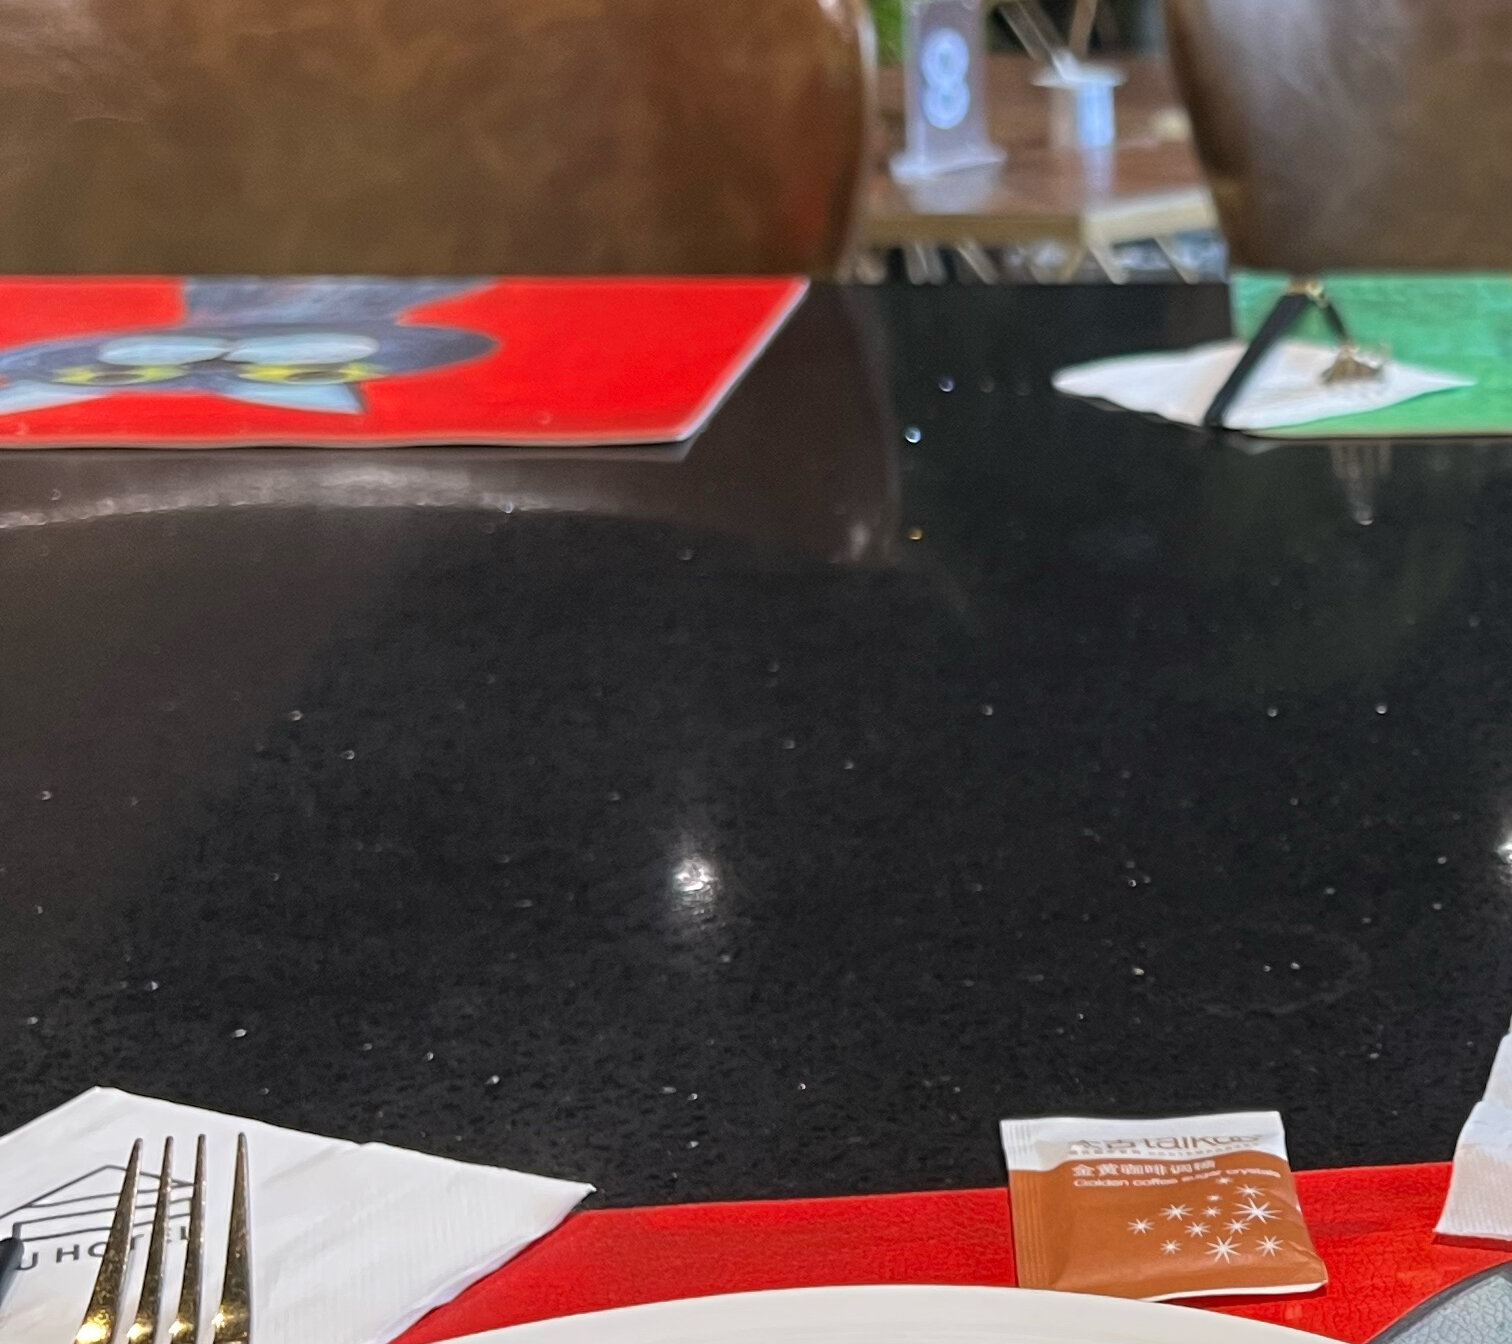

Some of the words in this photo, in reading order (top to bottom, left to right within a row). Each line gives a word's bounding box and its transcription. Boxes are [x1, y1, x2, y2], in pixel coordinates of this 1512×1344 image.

[921, 27, 970, 129] 8
[1073, 1178, 1130, 1187] Golden
[1132, 1177, 1178, 1187] coffee
